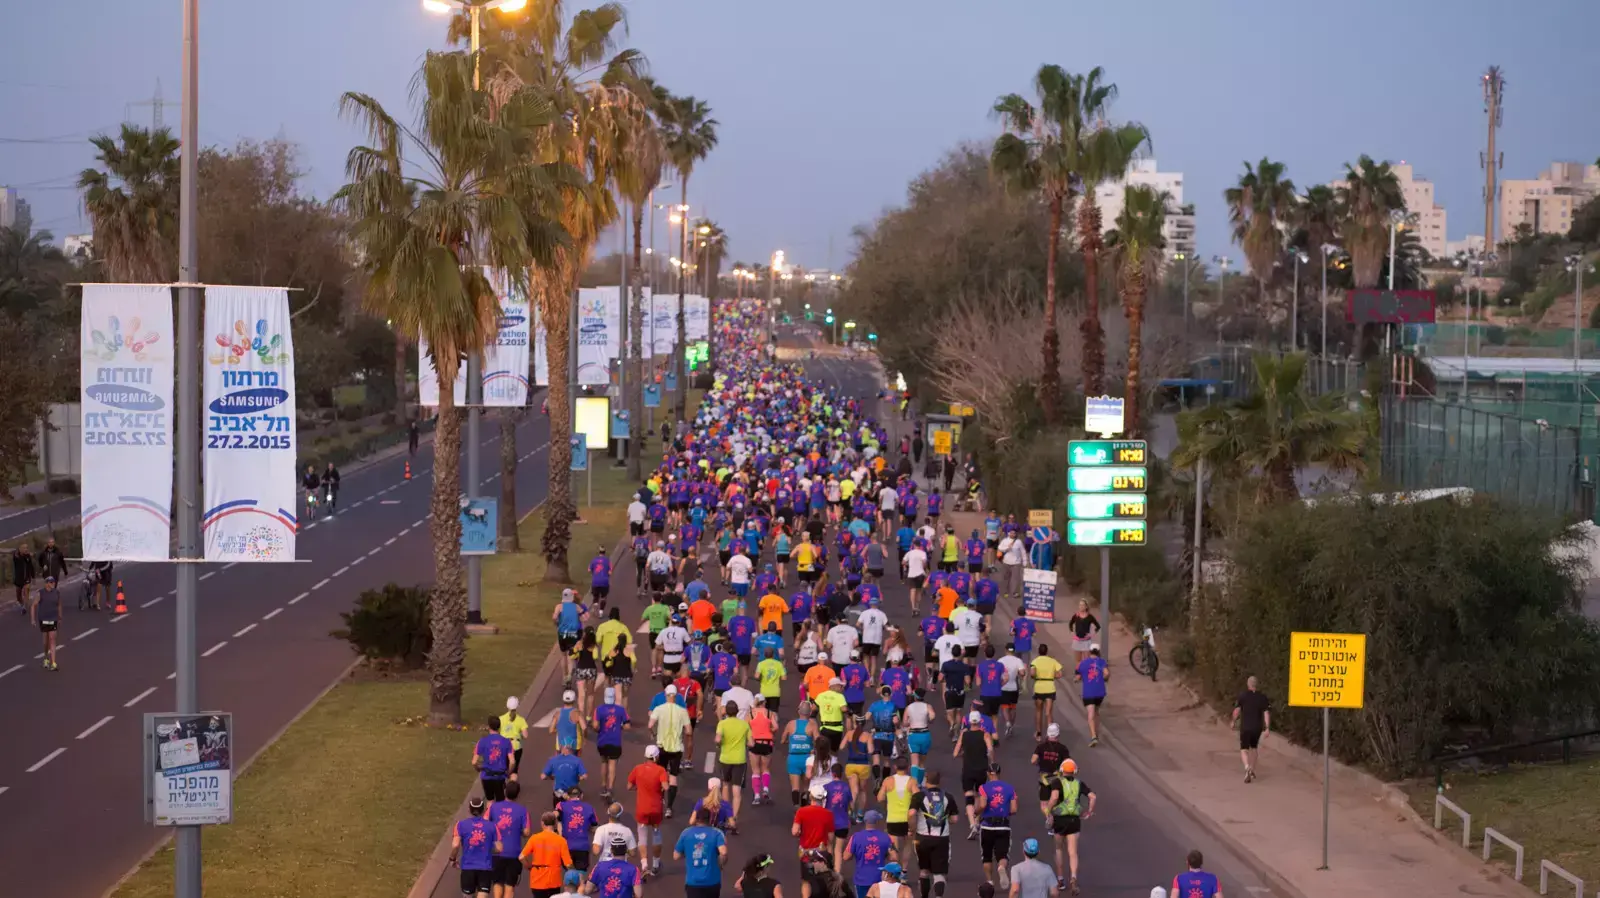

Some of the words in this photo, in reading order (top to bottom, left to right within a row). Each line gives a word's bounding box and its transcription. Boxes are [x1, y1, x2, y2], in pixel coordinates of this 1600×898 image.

[505, 307, 523, 315] Aviv
[222, 370, 279, 387] מרתון
[219, 395, 281, 408] SAMSUNG
[207, 434, 291, 450] 27.2.2015
[1113, 476, 1144, 488] חינם
[1309, 637, 1347, 648] זהירות!
[1299, 651, 1358, 662] אוטובוסים
[1308, 664, 1348, 675] עוצרים
[1309, 678, 1344, 688] בתחנה
[1311, 690, 1341, 702] לפניך
[168, 776, 219, 790] מהפכה
[168, 790, 219, 803] דיגיטלית
